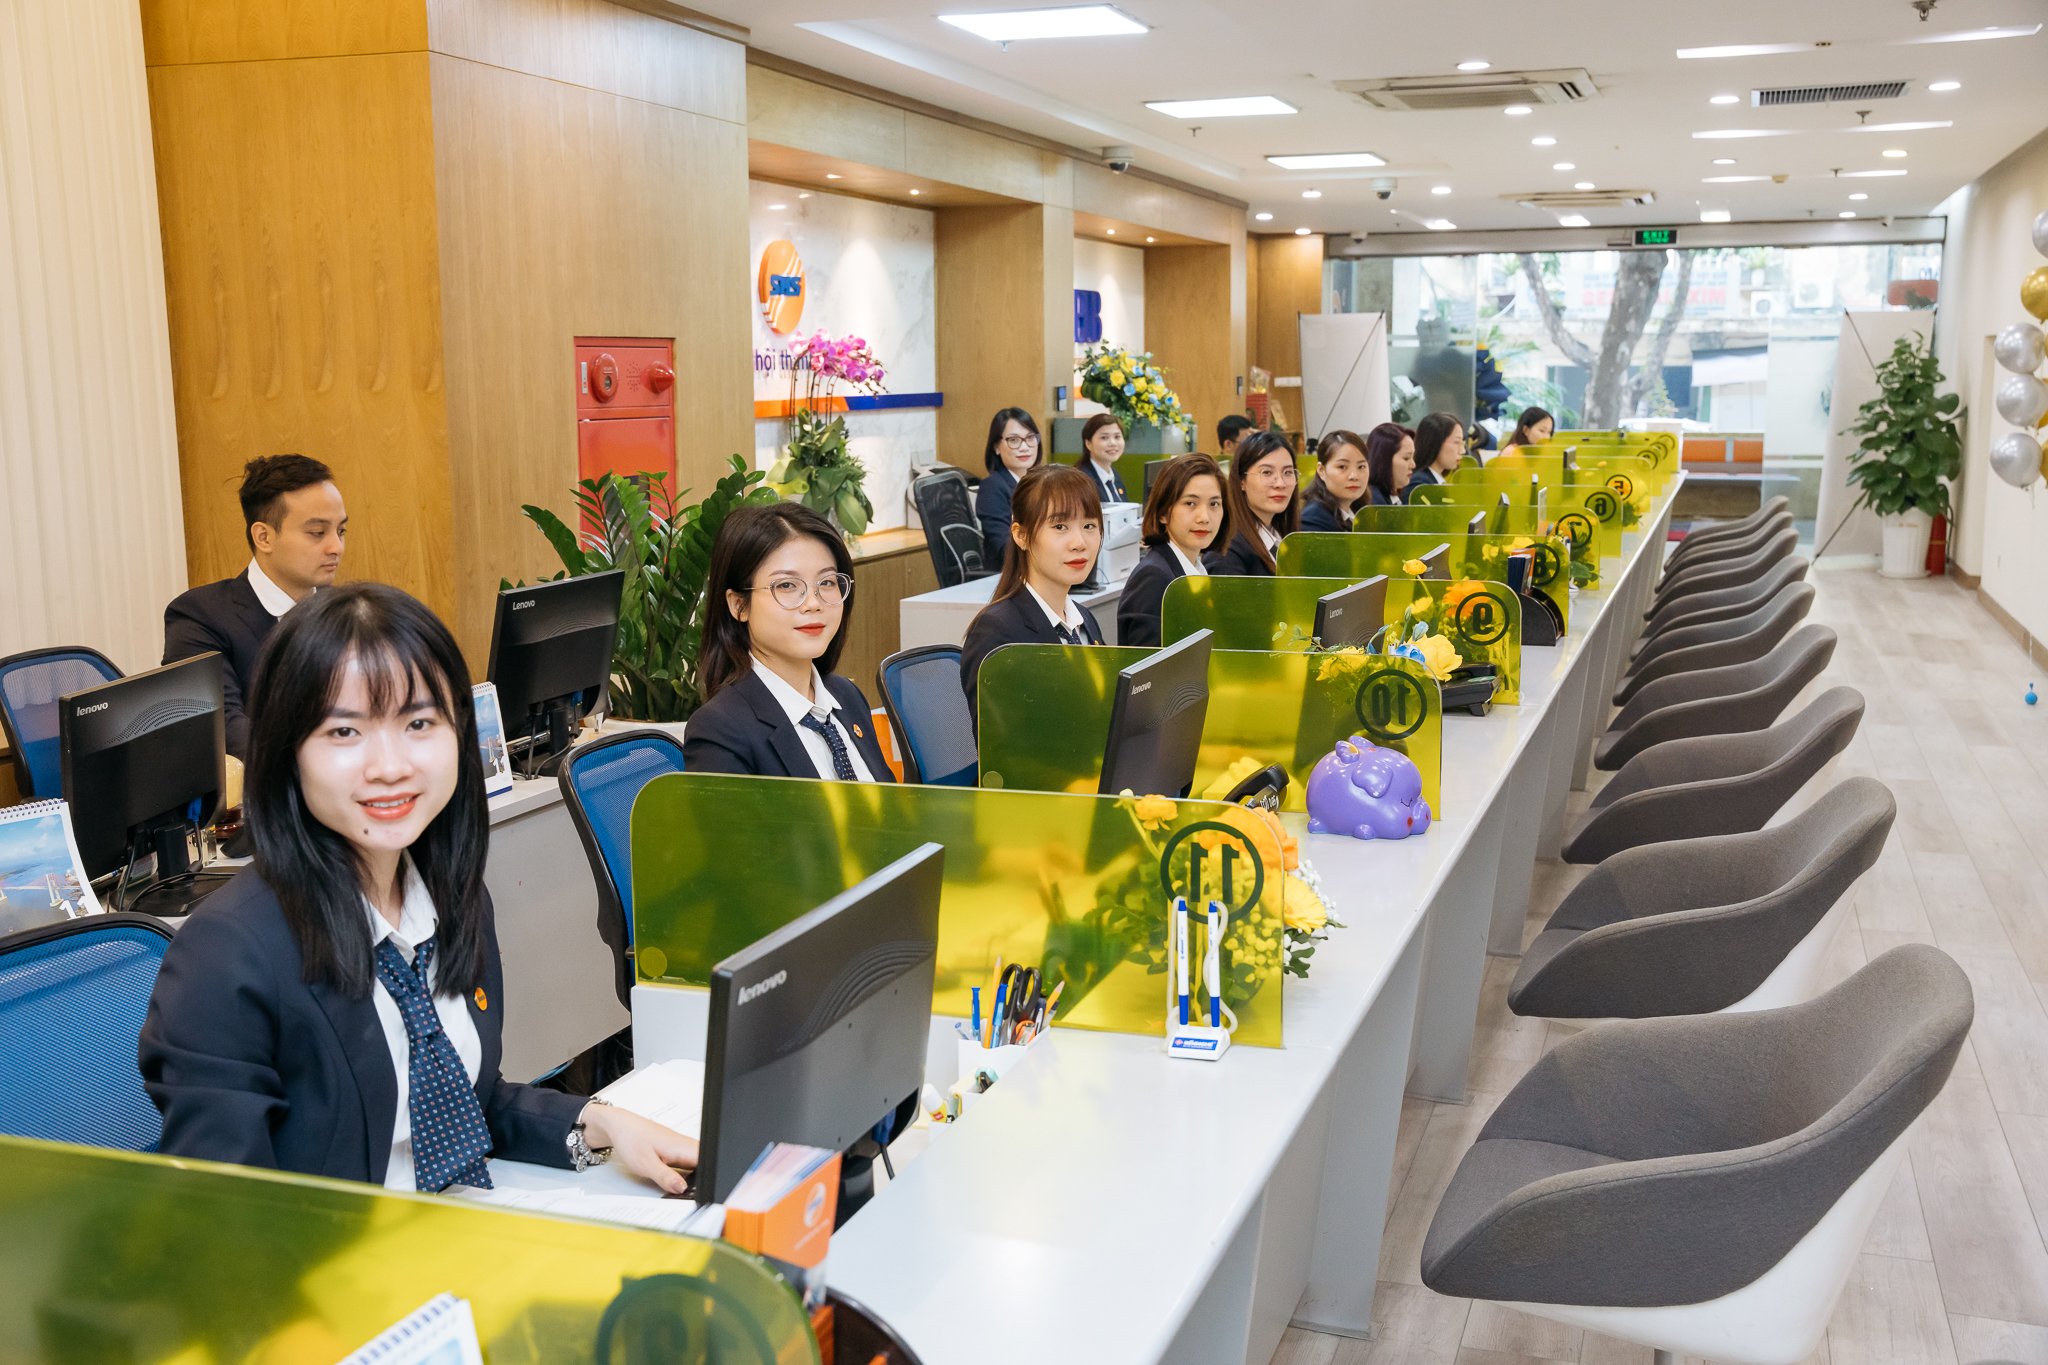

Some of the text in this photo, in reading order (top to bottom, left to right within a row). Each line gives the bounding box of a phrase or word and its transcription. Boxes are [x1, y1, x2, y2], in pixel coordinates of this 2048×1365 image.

[755, 348, 775, 376] hội
[512, 599, 536, 611] Lenovo
[76, 700, 109, 717] lenovo
[737, 969, 788, 1006] lenovo
